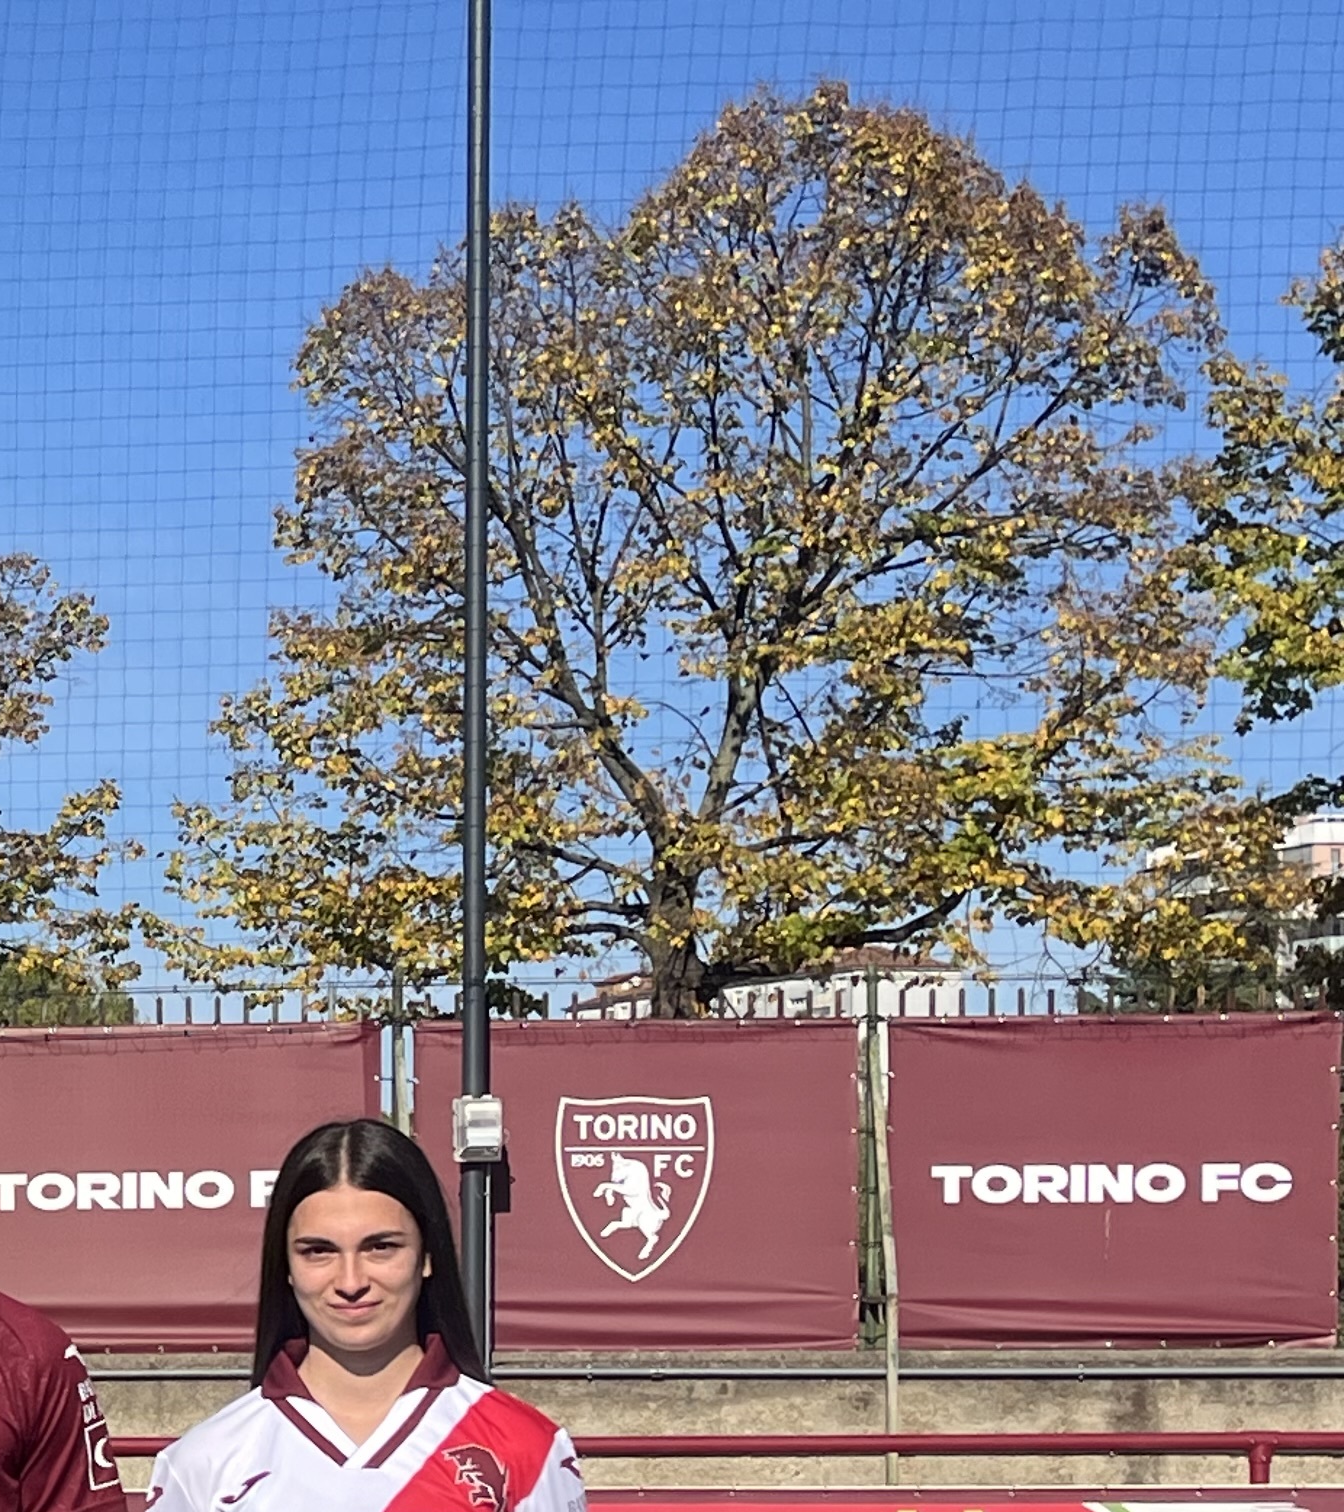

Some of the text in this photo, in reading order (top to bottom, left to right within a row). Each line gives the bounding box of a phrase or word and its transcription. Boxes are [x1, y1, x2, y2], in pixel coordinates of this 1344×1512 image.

[573, 1113, 697, 1140] TORINO
[653, 1153, 695, 1178] FC
[249, 1170, 281, 1208] F
[930, 1162, 1293, 1204] TORINO FC
